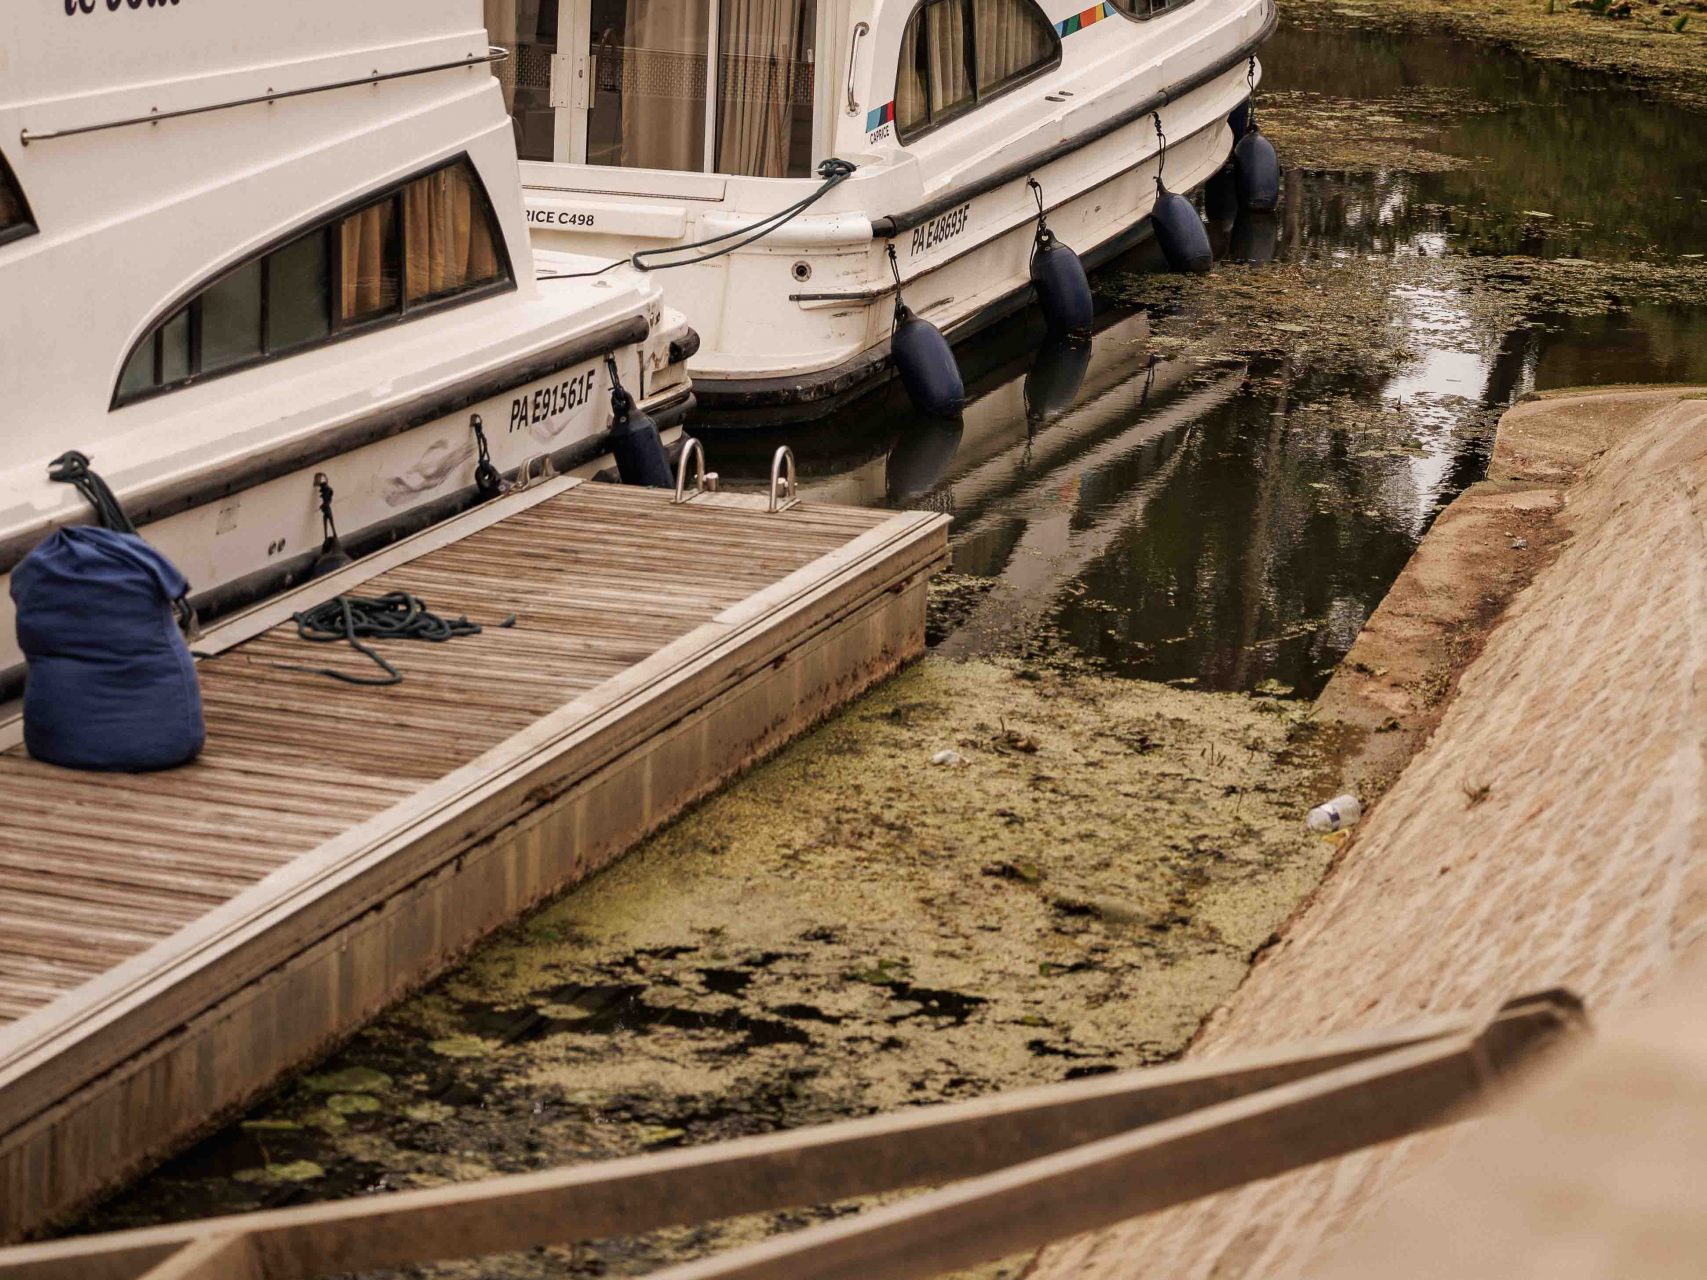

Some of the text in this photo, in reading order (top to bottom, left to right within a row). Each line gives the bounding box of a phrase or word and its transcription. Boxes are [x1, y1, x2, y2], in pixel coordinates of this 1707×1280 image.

[869, 125, 890, 145] CAPRICE
[558, 212, 594, 226] C498
[910, 203, 970, 257] PA E48693F
[509, 368, 596, 434] PA E91561F
